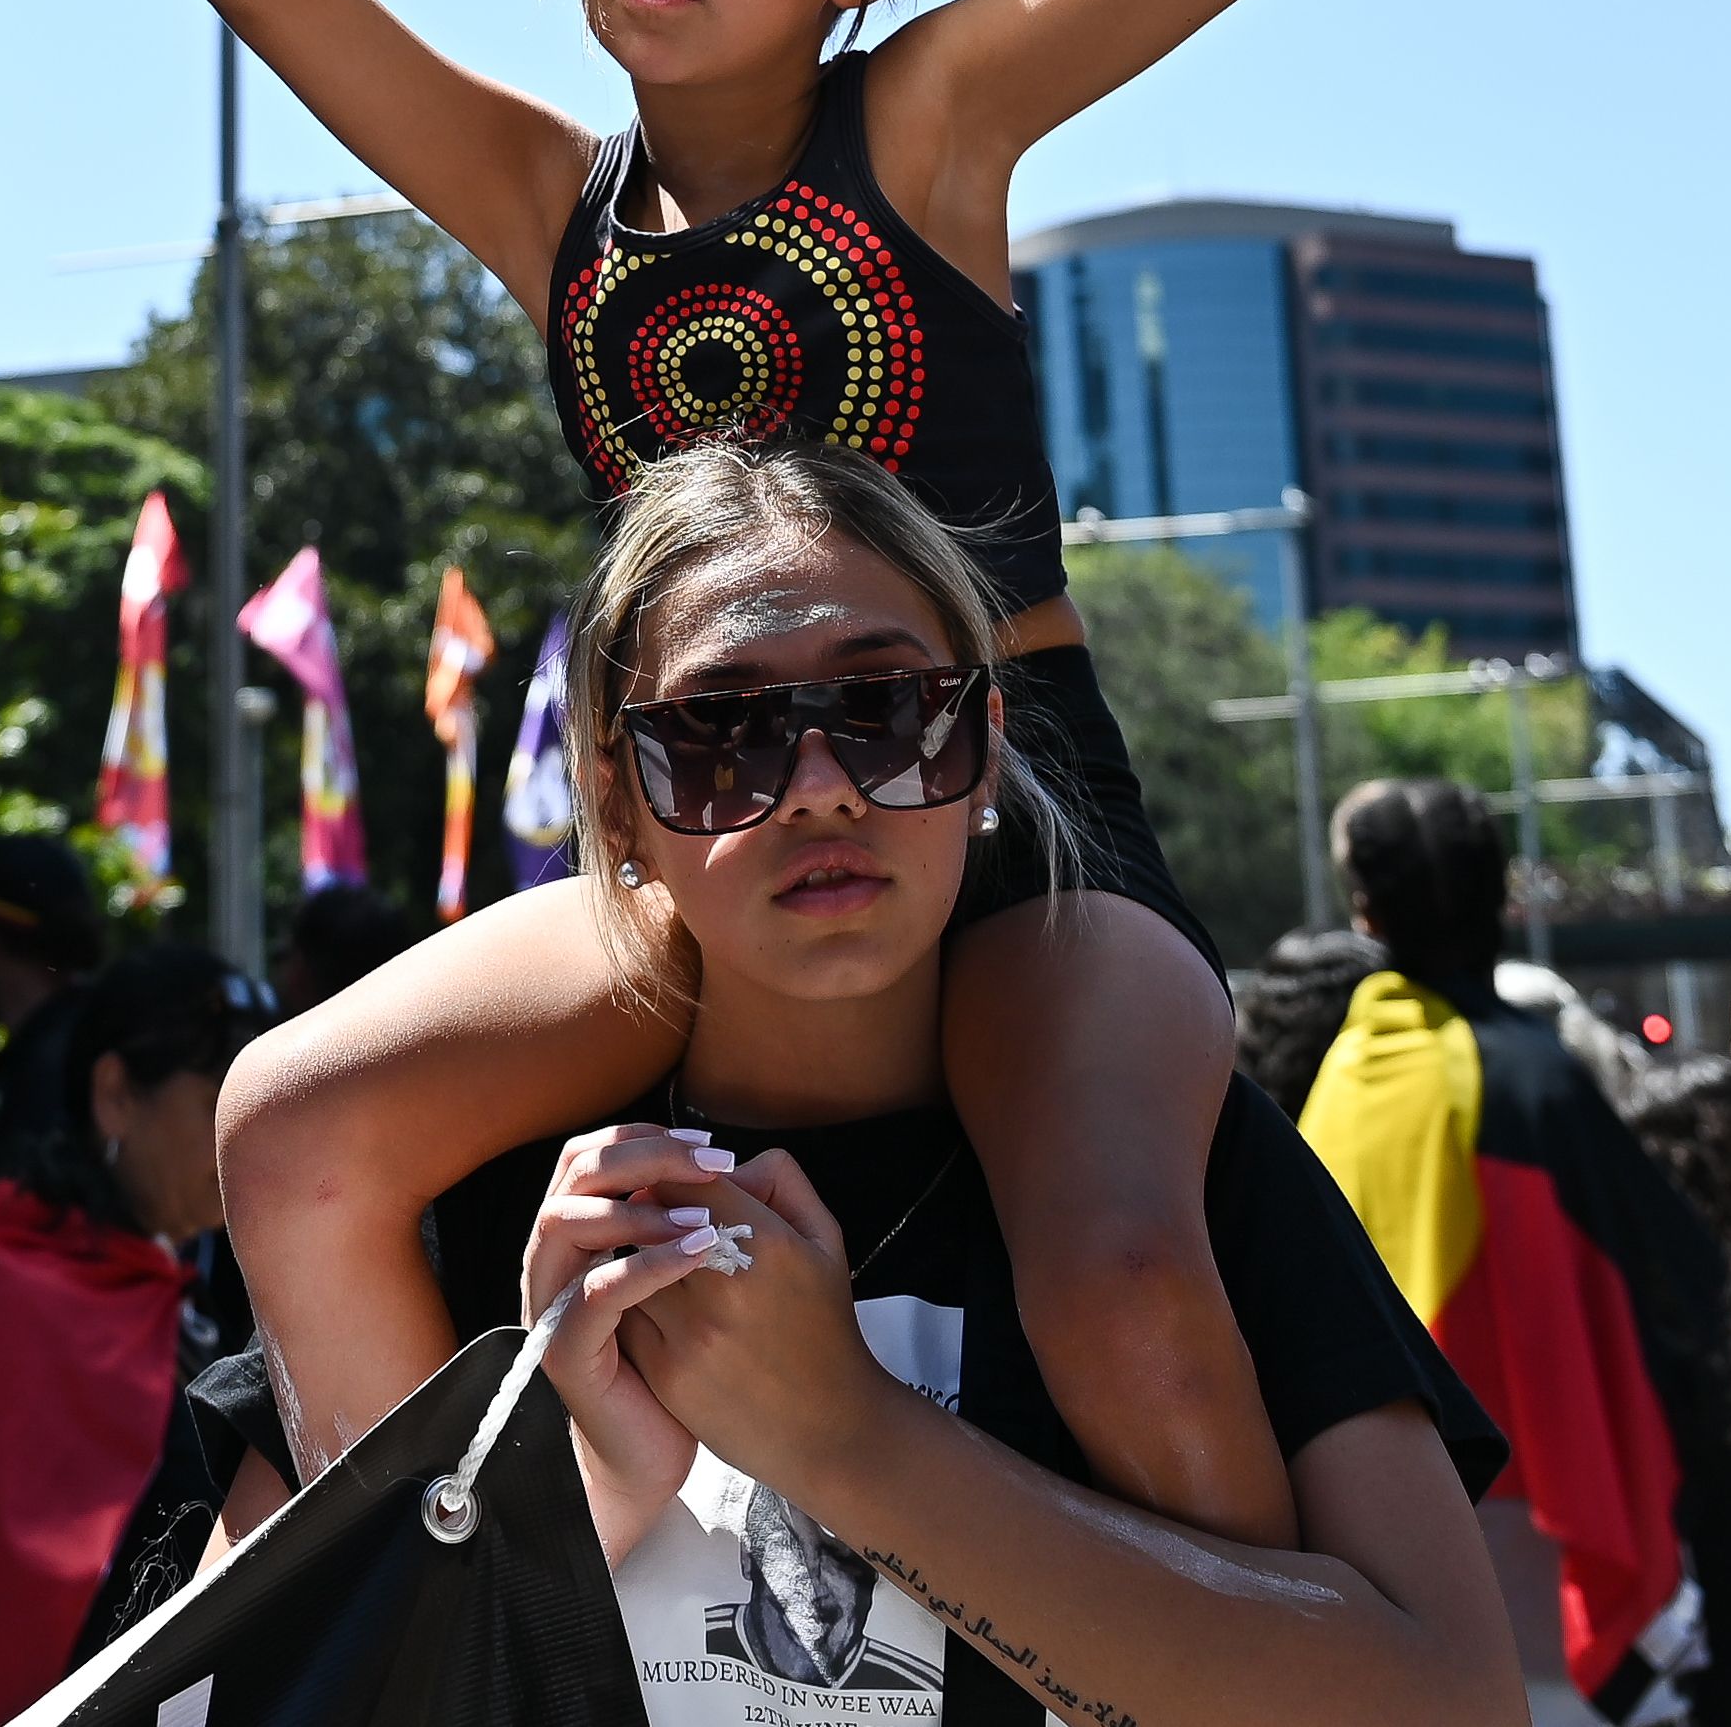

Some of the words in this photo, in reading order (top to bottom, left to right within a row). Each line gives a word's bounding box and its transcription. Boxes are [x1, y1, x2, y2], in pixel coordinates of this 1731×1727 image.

[939, 677, 962, 688] QUAY
[928, 1595, 964, 1621] في
[964, 1616, 1038, 1670] الجمال
[641, 1660, 776, 1698] MURDERED
[780, 1684, 809, 1708] IN
[813, 1691, 872, 1714] WEE
[877, 1696, 939, 1717] WAA
[744, 1704, 790, 1727] 12TH
